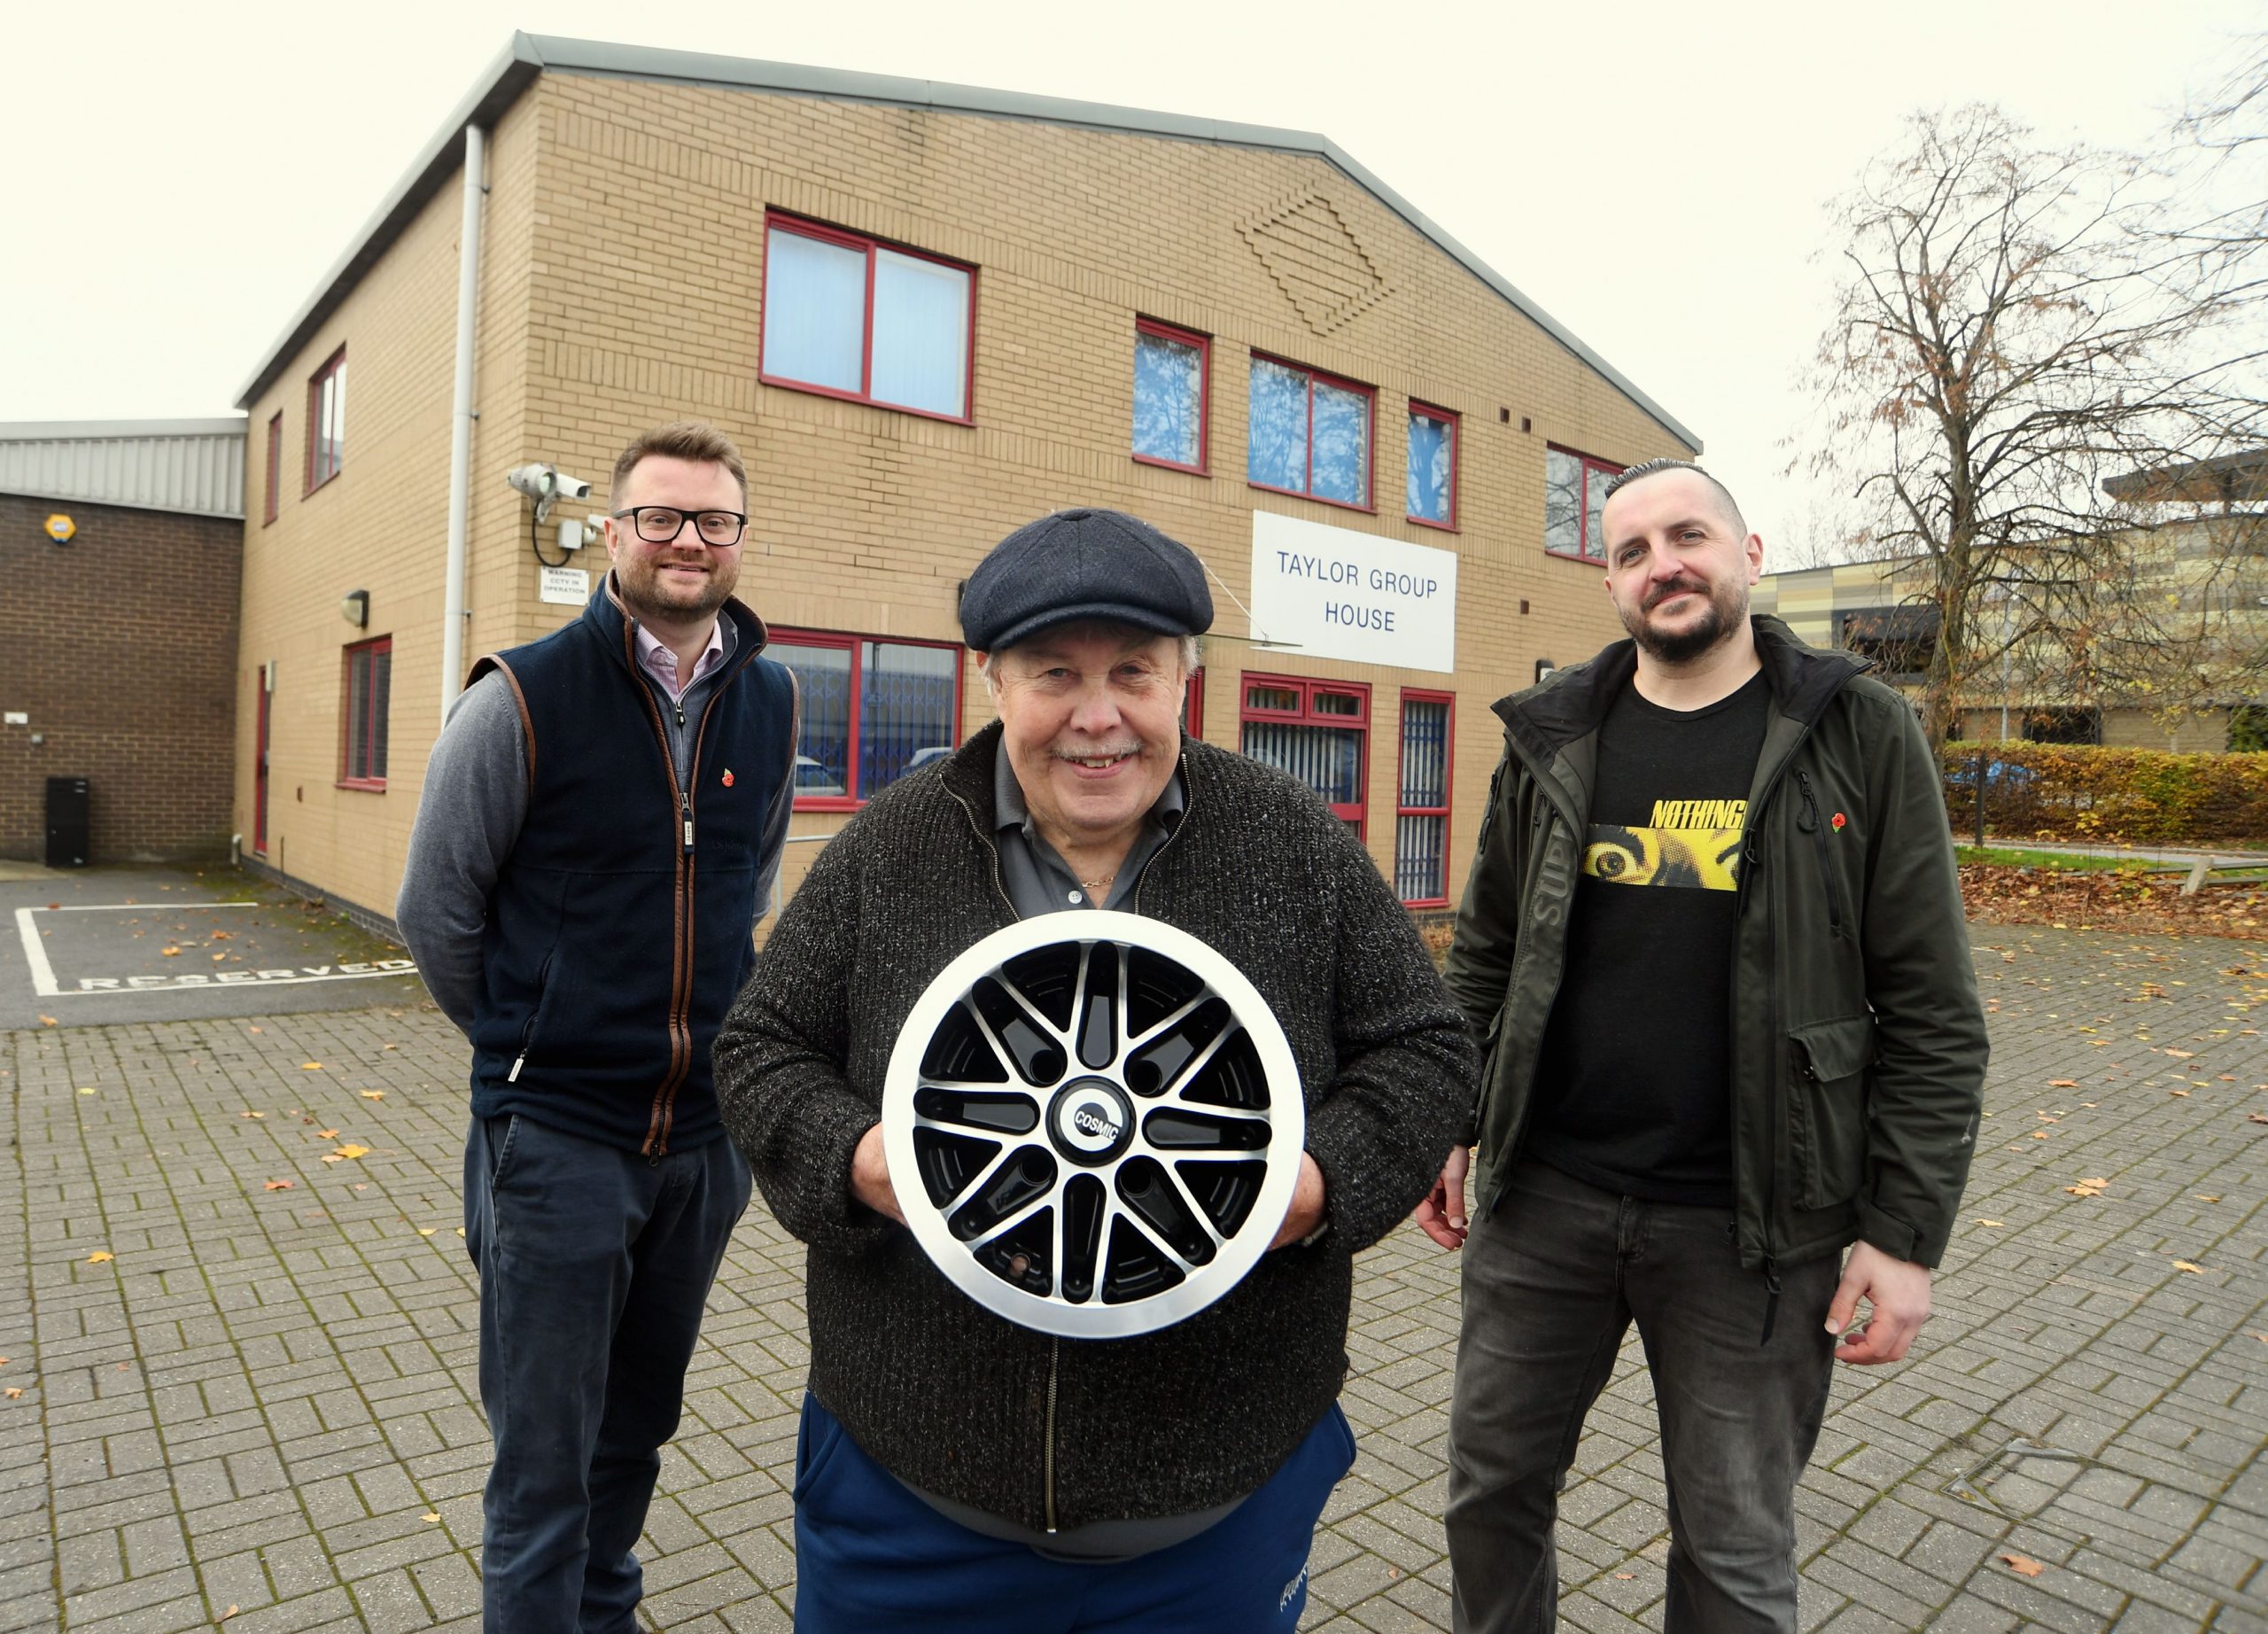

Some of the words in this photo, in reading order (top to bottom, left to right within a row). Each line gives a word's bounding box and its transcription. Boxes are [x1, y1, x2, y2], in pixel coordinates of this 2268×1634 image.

[548, 569, 582, 578] WARNING
[1277, 550, 1359, 586] TAYLOR
[1370, 569, 1437, 598] GROUP
[1325, 602, 1395, 632] HOUSE
[79, 959, 415, 991] RESERVED
[1075, 1110, 1119, 1140] COSMIC
